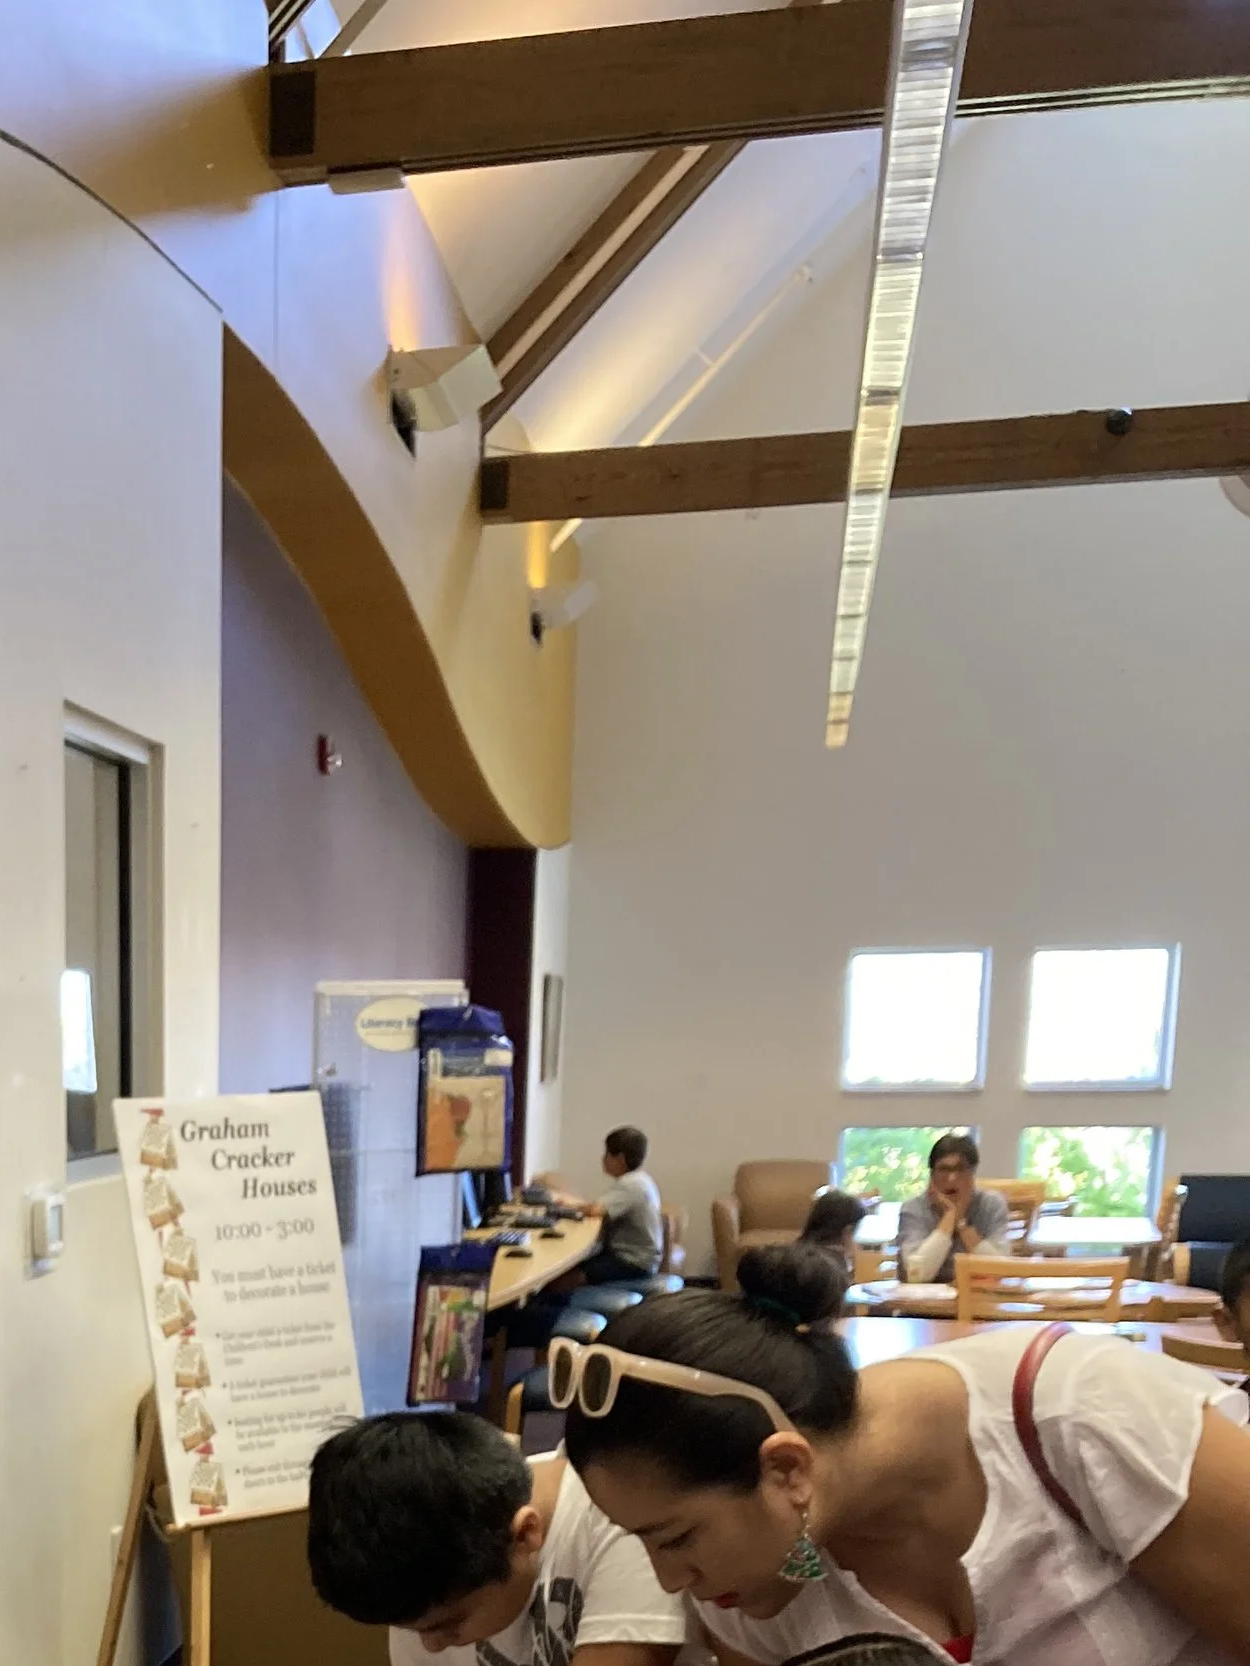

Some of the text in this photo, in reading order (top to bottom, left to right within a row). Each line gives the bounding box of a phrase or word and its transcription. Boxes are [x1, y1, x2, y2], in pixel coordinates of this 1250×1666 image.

[180, 1117, 270, 1142] Graham
[211, 1146, 295, 1171] Cracker
[241, 1177, 318, 1199] Houses
[214, 1222, 262, 1241] 10:00
[276, 1218, 315, 1240] 3:00
[268, 1263, 296, 1280] have
[306, 1260, 337, 1274] ticket
